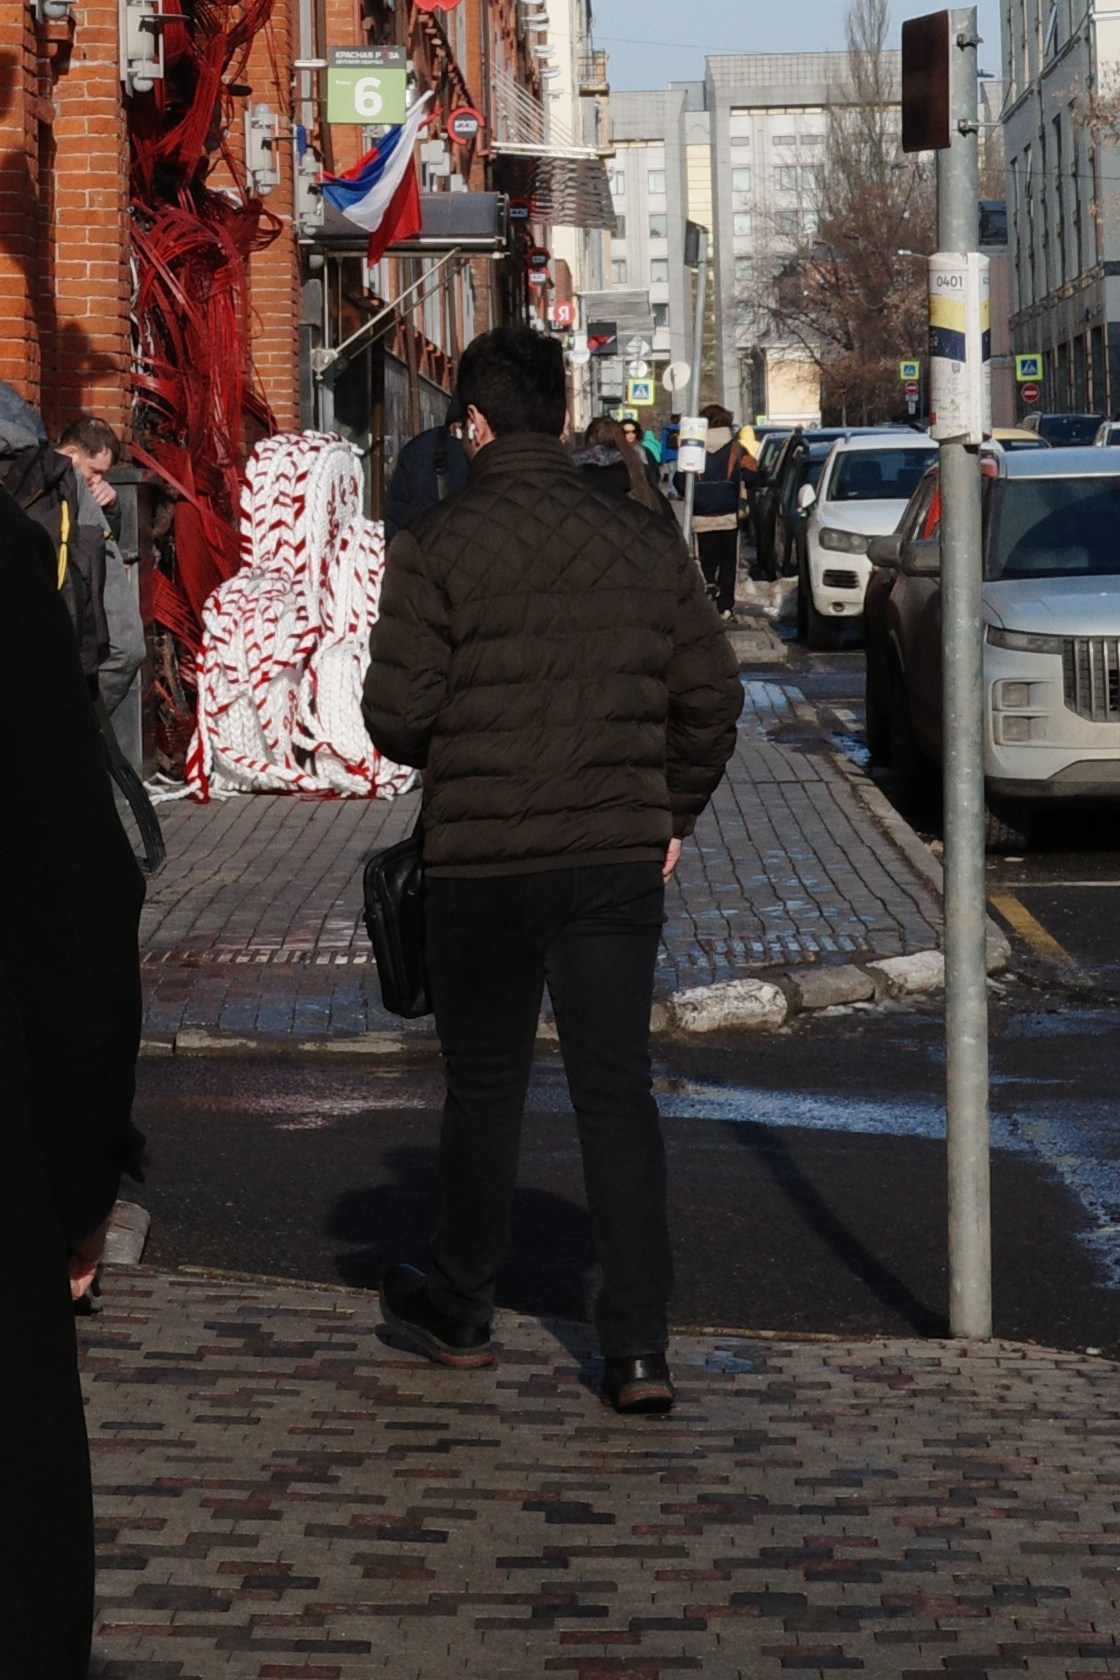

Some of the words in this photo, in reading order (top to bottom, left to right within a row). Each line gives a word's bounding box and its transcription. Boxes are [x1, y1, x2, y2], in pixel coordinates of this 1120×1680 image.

[354, 76, 383, 117] 6
[936, 275, 963, 288] 0401
[558, 305, 570, 321] Я
